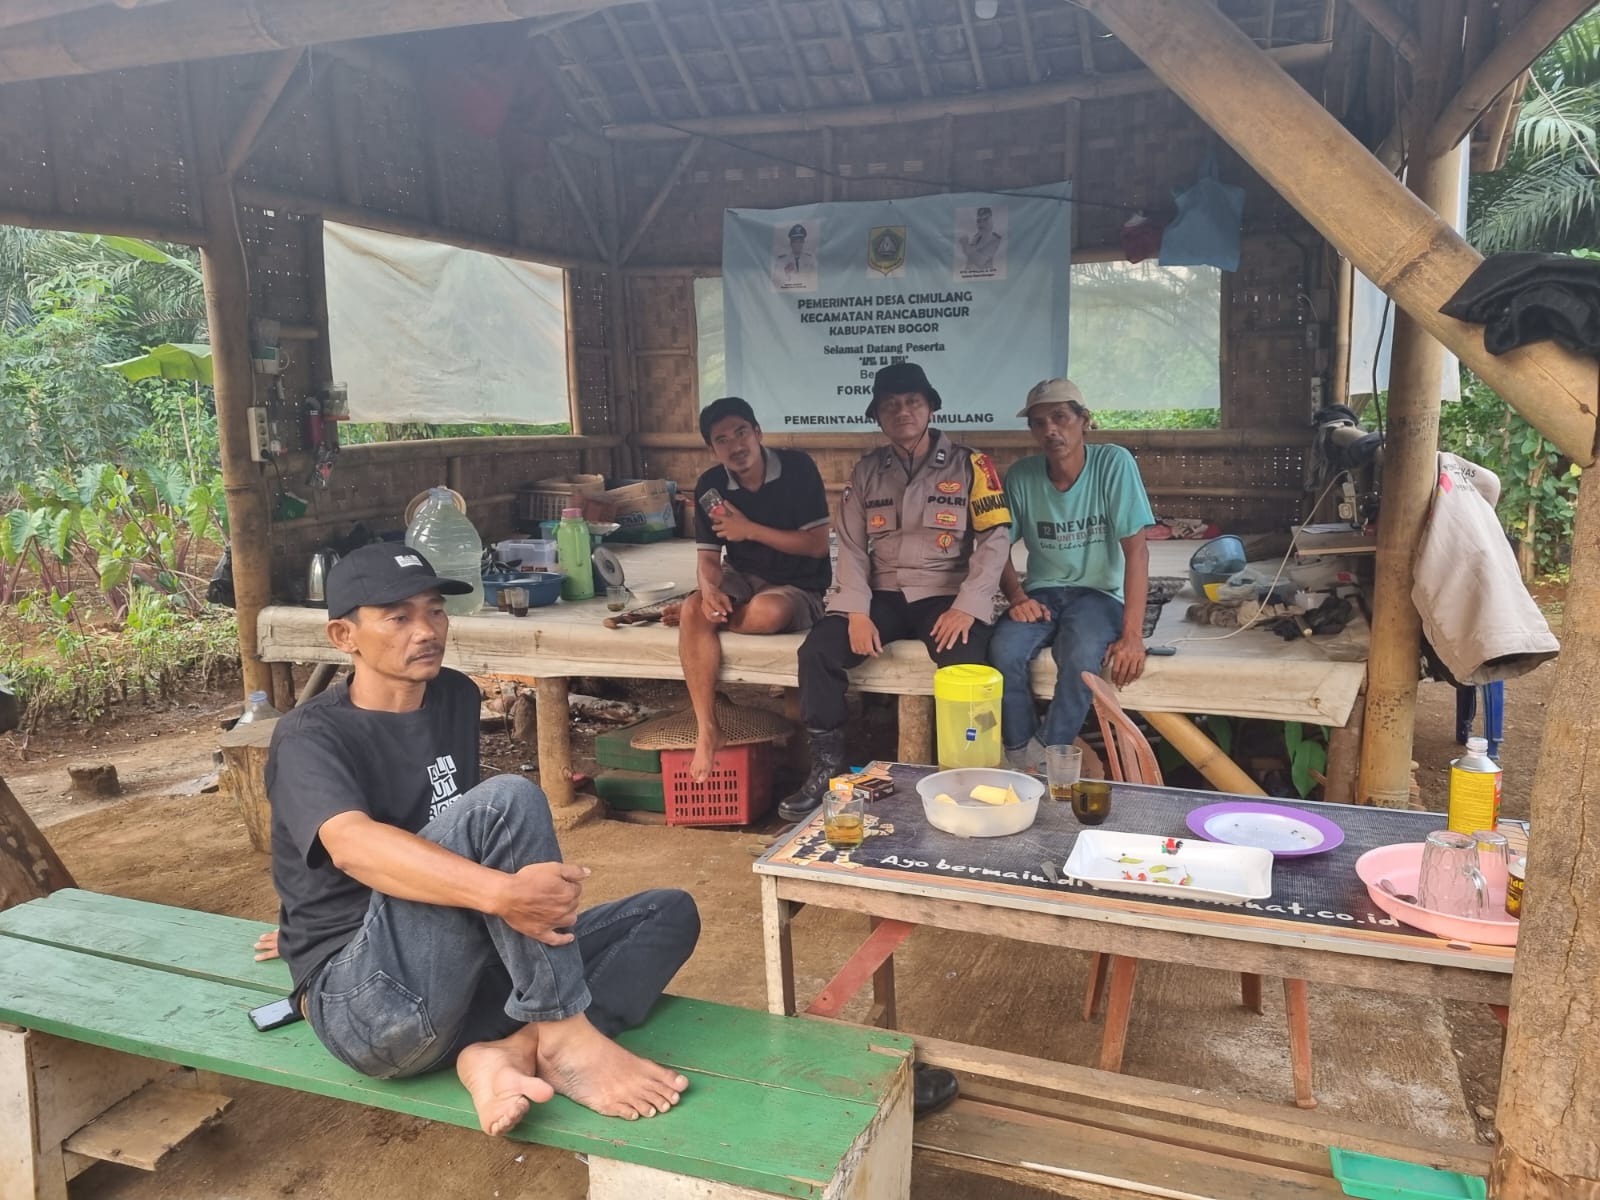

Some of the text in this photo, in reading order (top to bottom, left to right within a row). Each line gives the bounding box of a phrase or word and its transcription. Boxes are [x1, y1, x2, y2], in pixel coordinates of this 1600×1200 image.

[797, 291, 973, 309] PEMERINTAH DESA CIMULANG
[800, 306, 970, 323] KECAMATAN RANCABUNGUR
[829, 323, 939, 336] KABUPATEN BOGOR
[823, 342, 945, 354] Selamat Datang Peserta
[860, 370, 875, 379] Be
[837, 386, 873, 395] FORK
[930, 413, 994, 423] IMULANG
[927, 496, 967, 506] POLRI
[427, 755, 457, 784] ALL
[431, 775, 458, 803] UT
[880, 855, 929, 868] Ayo
[936, 859, 1049, 882] bermain
